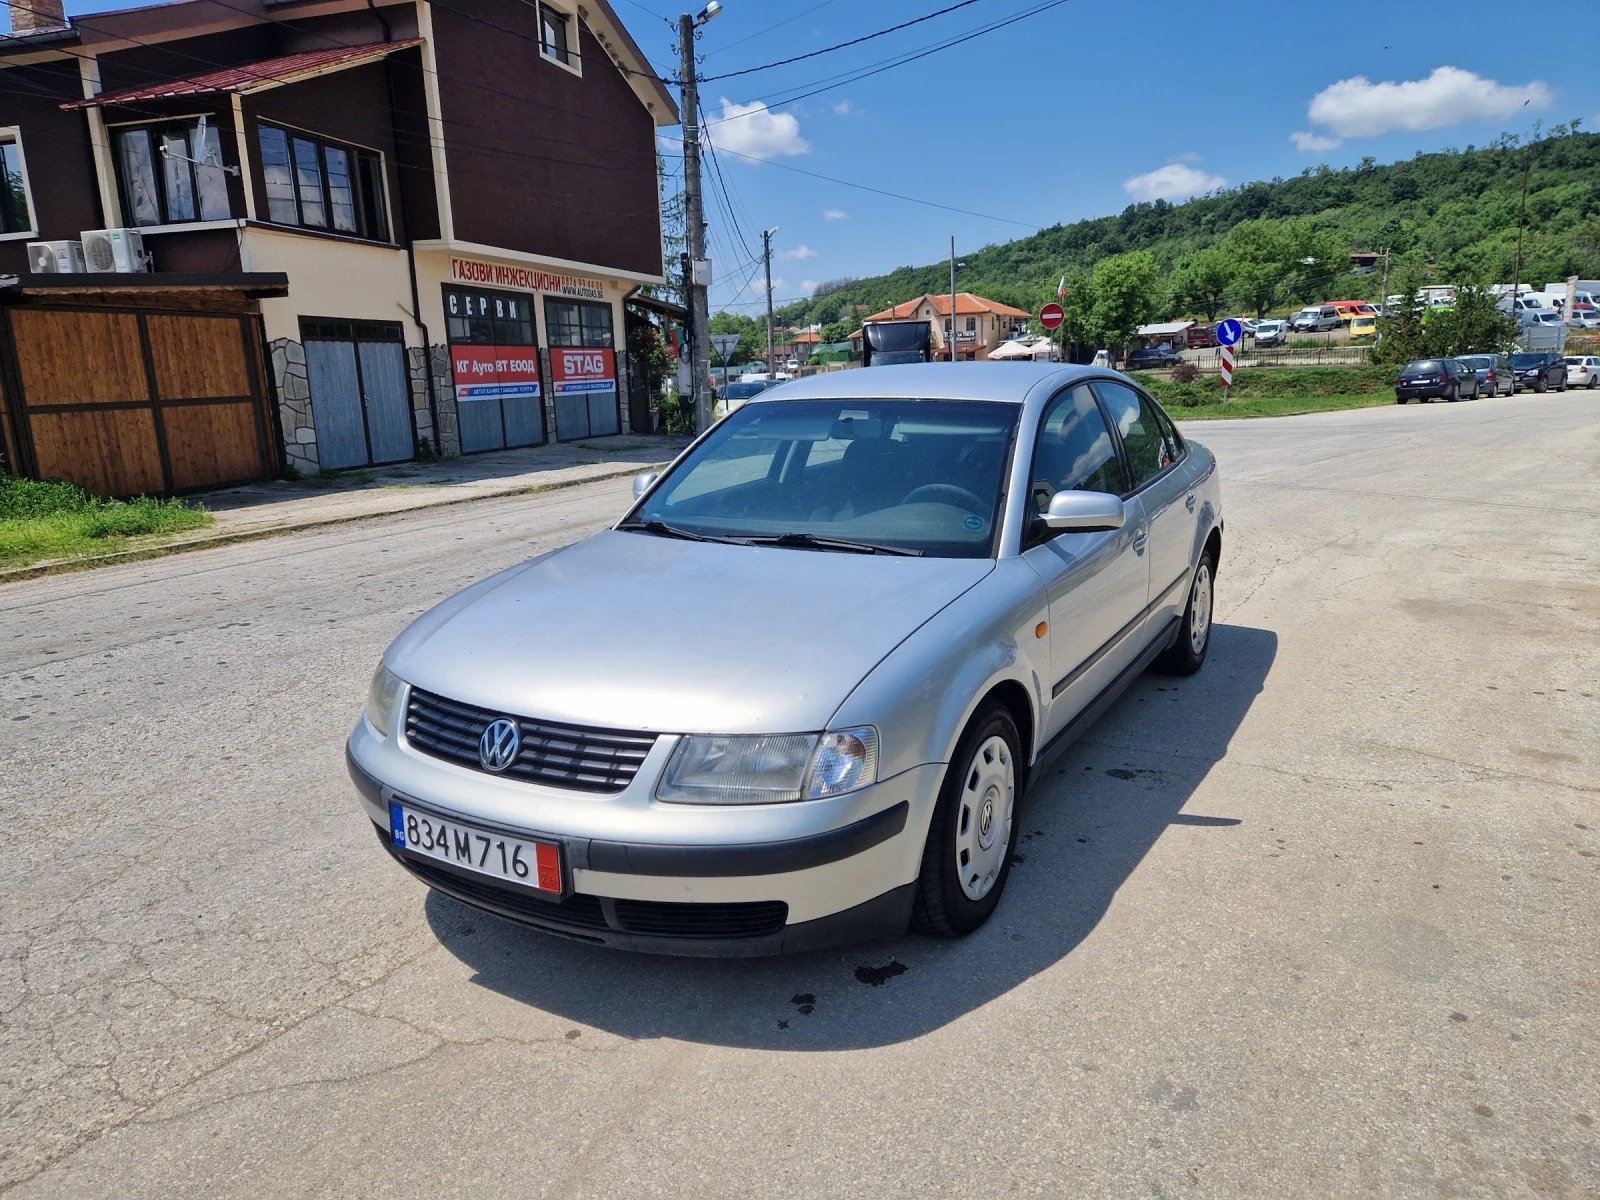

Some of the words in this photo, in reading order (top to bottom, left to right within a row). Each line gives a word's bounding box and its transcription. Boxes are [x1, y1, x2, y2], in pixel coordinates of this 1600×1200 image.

[452, 259, 493, 283] ГАЗОВИ
[495, 265, 562, 293] ИНЖЕКЦИОНИ
[456, 360, 469, 373] КГ
[472, 360, 494, 376] Ауто
[496, 360, 508, 373] ВТ
[510, 359, 536, 374] ЕООД
[563, 355, 604, 375] STAG
